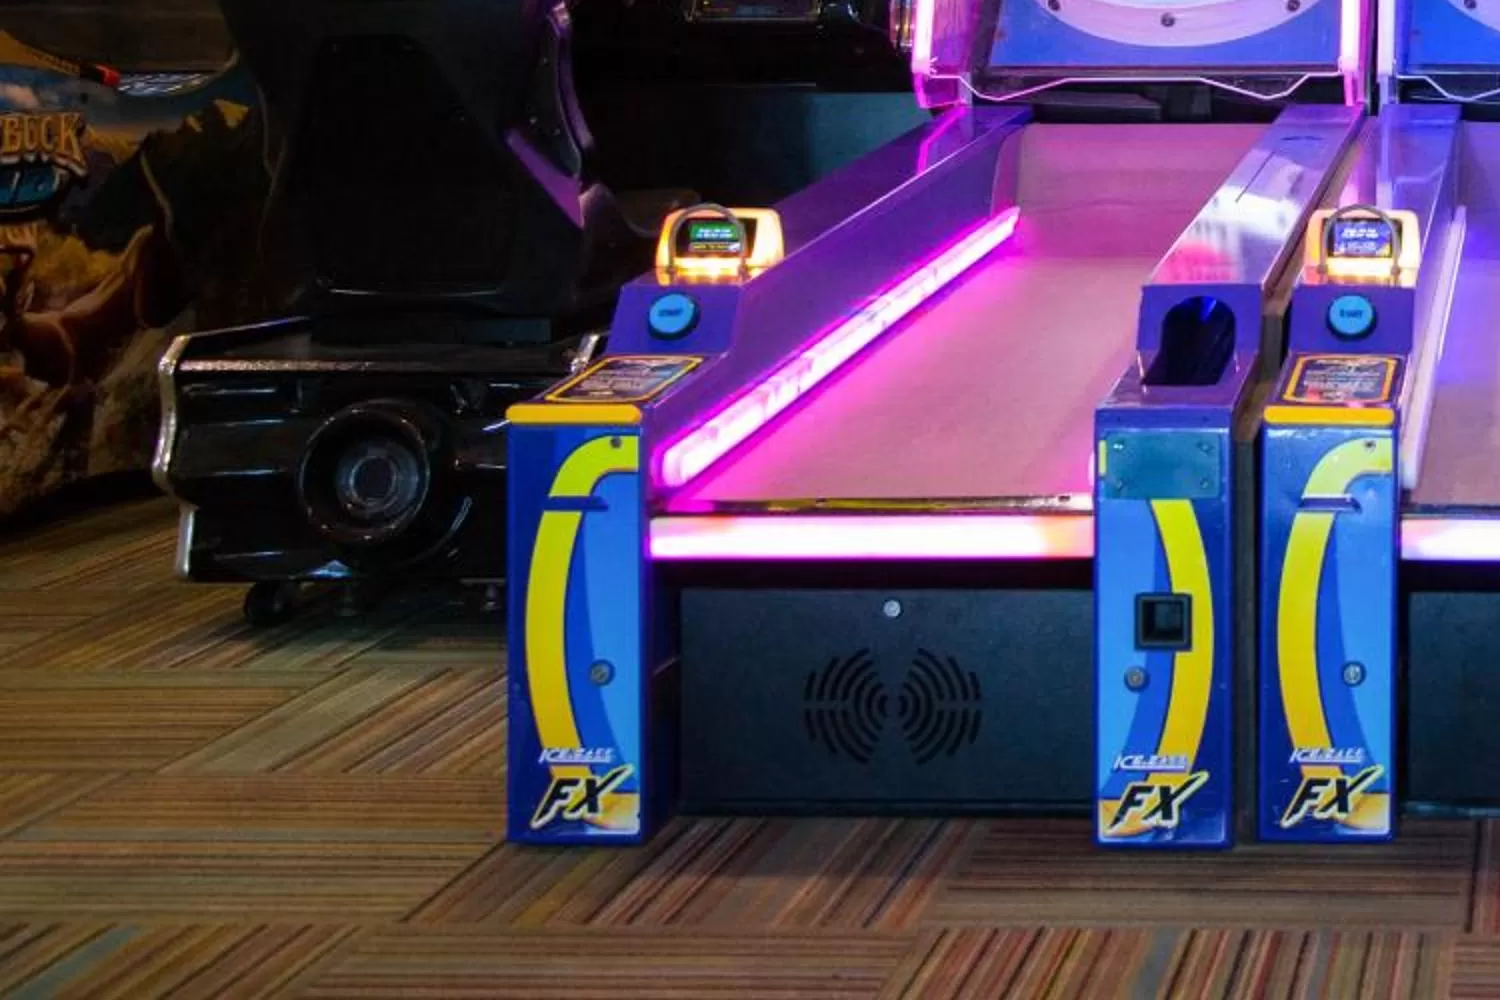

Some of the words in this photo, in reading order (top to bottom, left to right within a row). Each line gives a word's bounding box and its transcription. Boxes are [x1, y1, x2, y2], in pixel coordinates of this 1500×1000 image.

[3, 114, 86, 168] BUCK
[530, 763, 634, 829] FX
[1105, 771, 1210, 834] FX
[1280, 764, 1384, 828] FX
